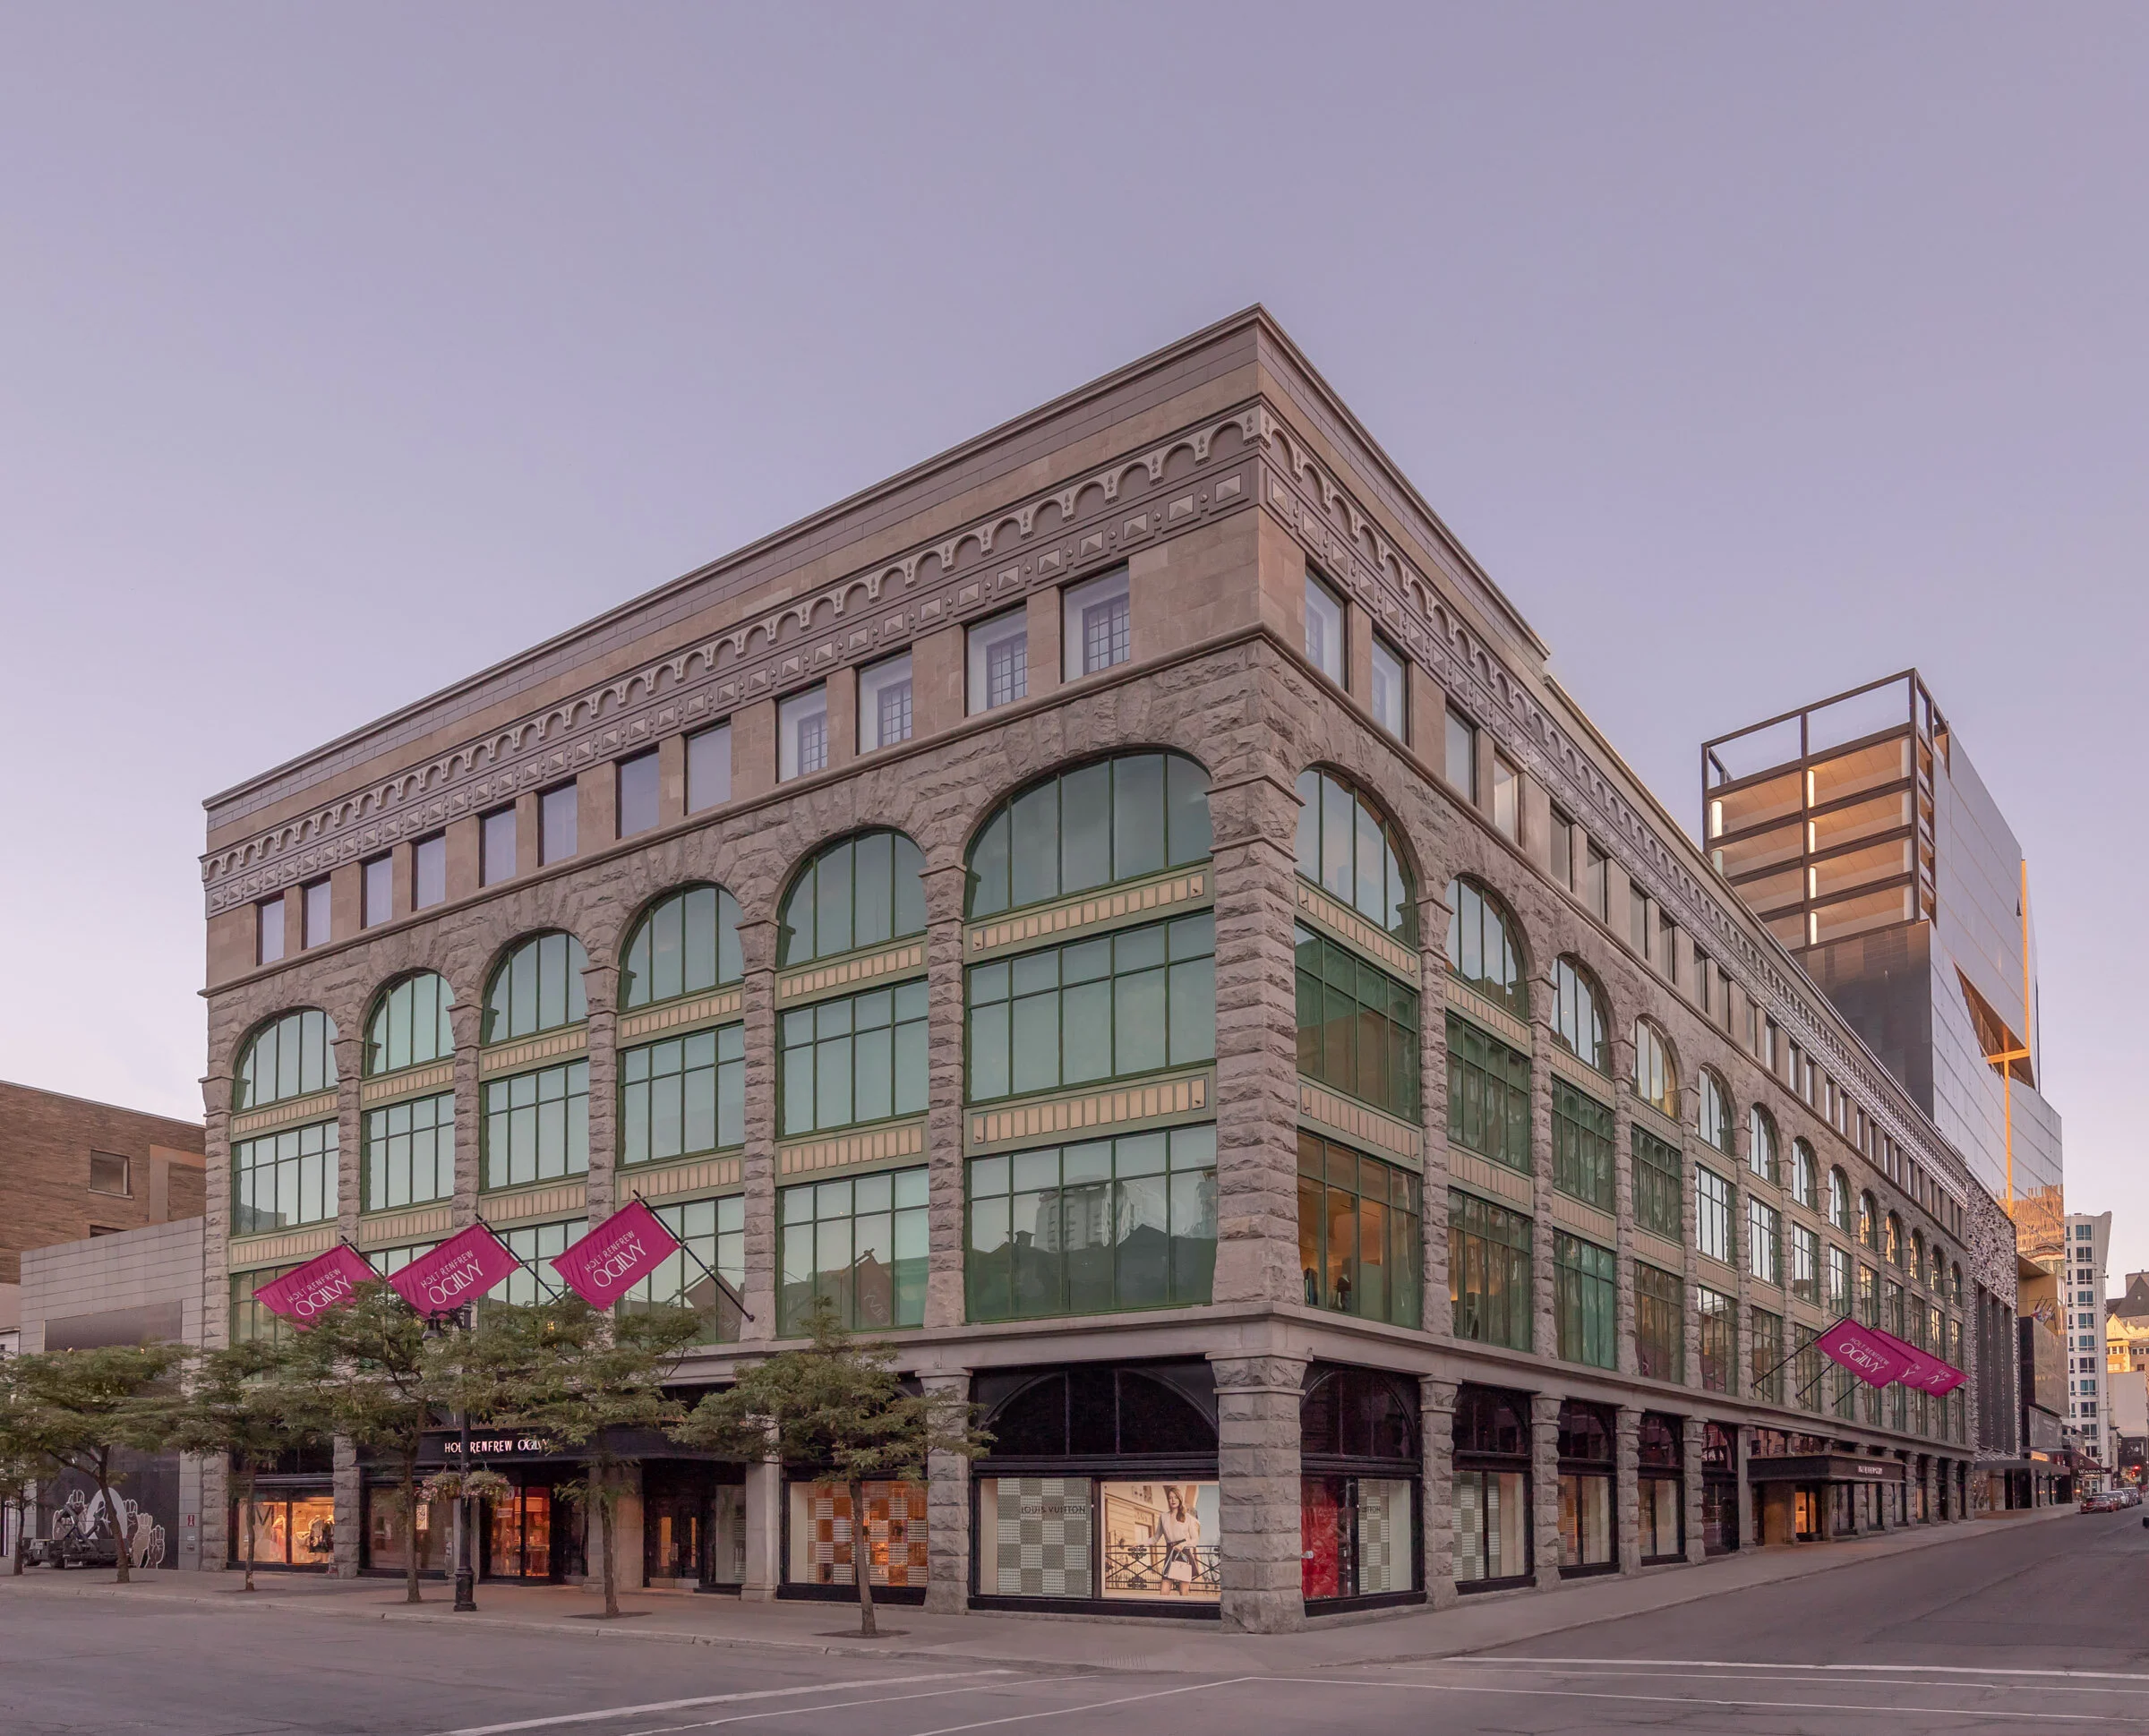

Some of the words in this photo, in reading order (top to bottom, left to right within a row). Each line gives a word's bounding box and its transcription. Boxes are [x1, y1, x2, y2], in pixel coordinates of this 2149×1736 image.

[420, 1271, 440, 1289] HOLT
[440, 1250, 475, 1277] RENFREW
[583, 1255, 604, 1272] HOLT
[602, 1230, 636, 1260] RENFREW
[592, 1239, 646, 1287] OGILVY
[287, 1288, 307, 1304] HOLT
[306, 1268, 342, 1292] RENFREW
[295, 1275, 353, 1316] OGILVY
[428, 1259, 484, 1304] OGILVY
[1838, 1343, 1885, 1373] OGILVY
[444, 1441, 463, 1453] HOL
[469, 1440, 514, 1454] RENFREW
[1021, 1505, 1047, 1515] LOUIS
[1048, 1505, 1086, 1515] VUITTON
